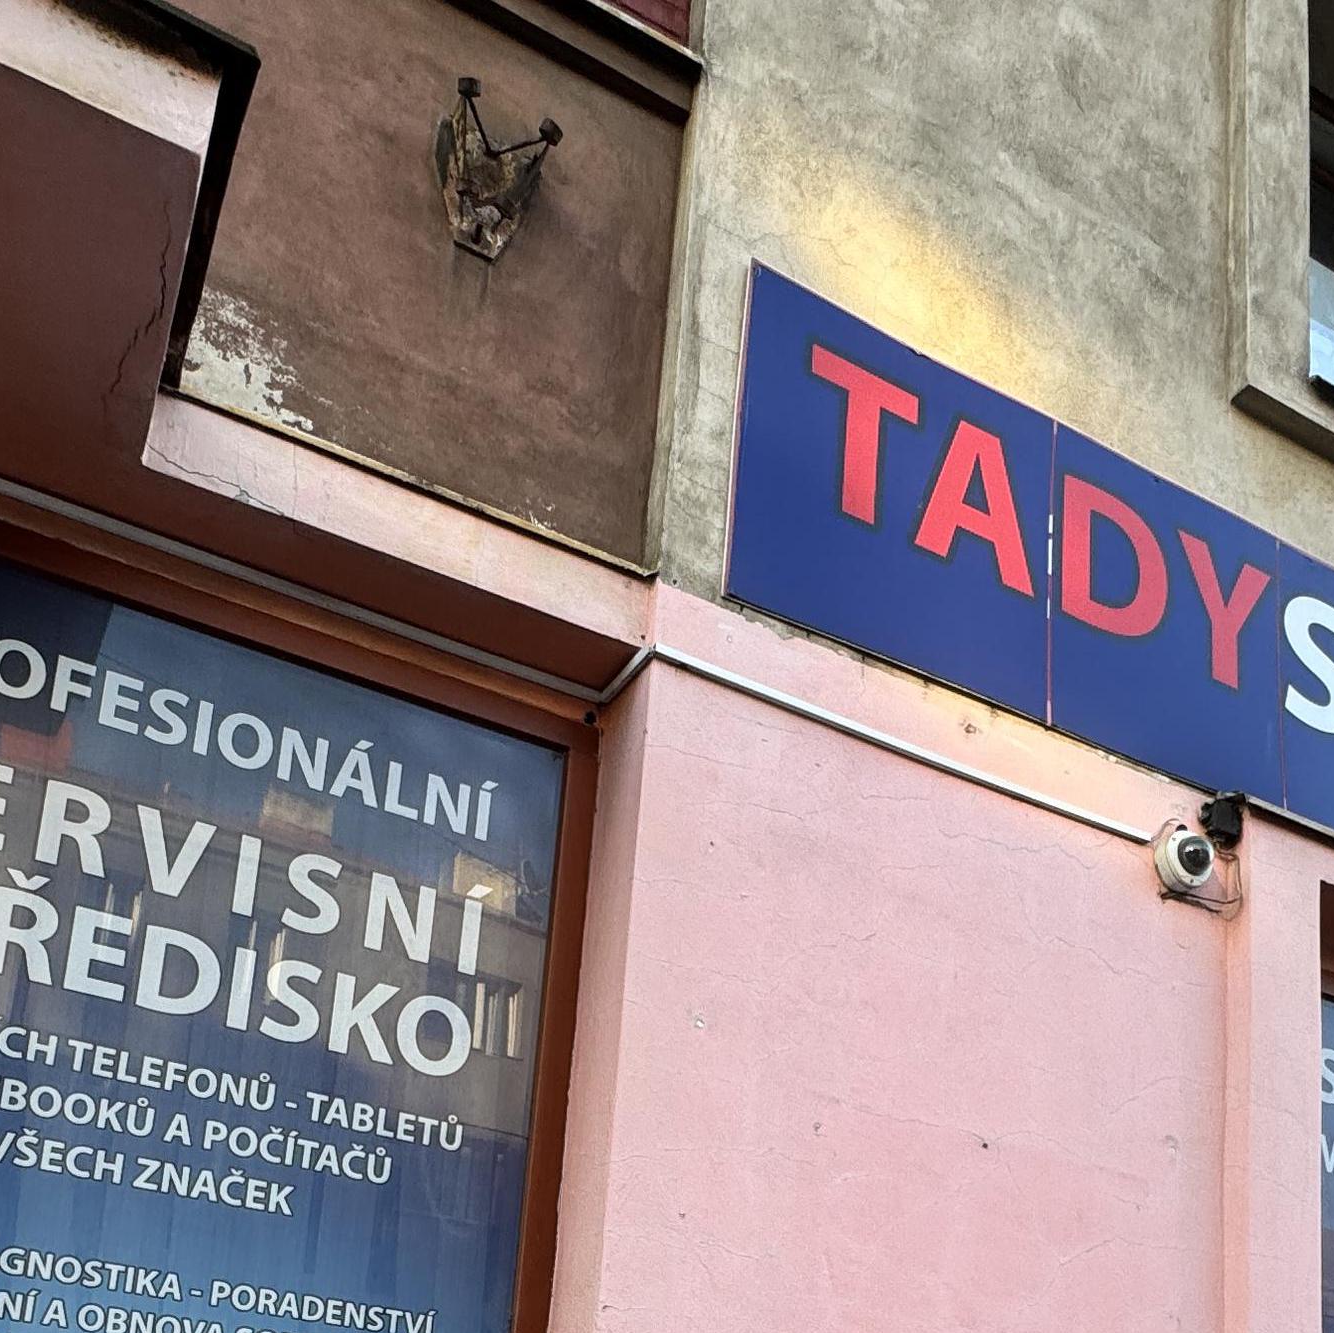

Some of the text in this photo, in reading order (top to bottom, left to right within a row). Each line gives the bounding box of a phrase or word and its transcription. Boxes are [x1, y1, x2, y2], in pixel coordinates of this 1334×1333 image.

[67, 1038, 275, 1112] TELEFONŮ
[306, 1090, 465, 1154] TABLETŮ
[164, 1113, 192, 1145] A
[204, 1121, 392, 1186] POČÍTAČŮ
[134, 1155, 295, 1216] ZNAČEK
[43, 1296, 69, 1327] A
